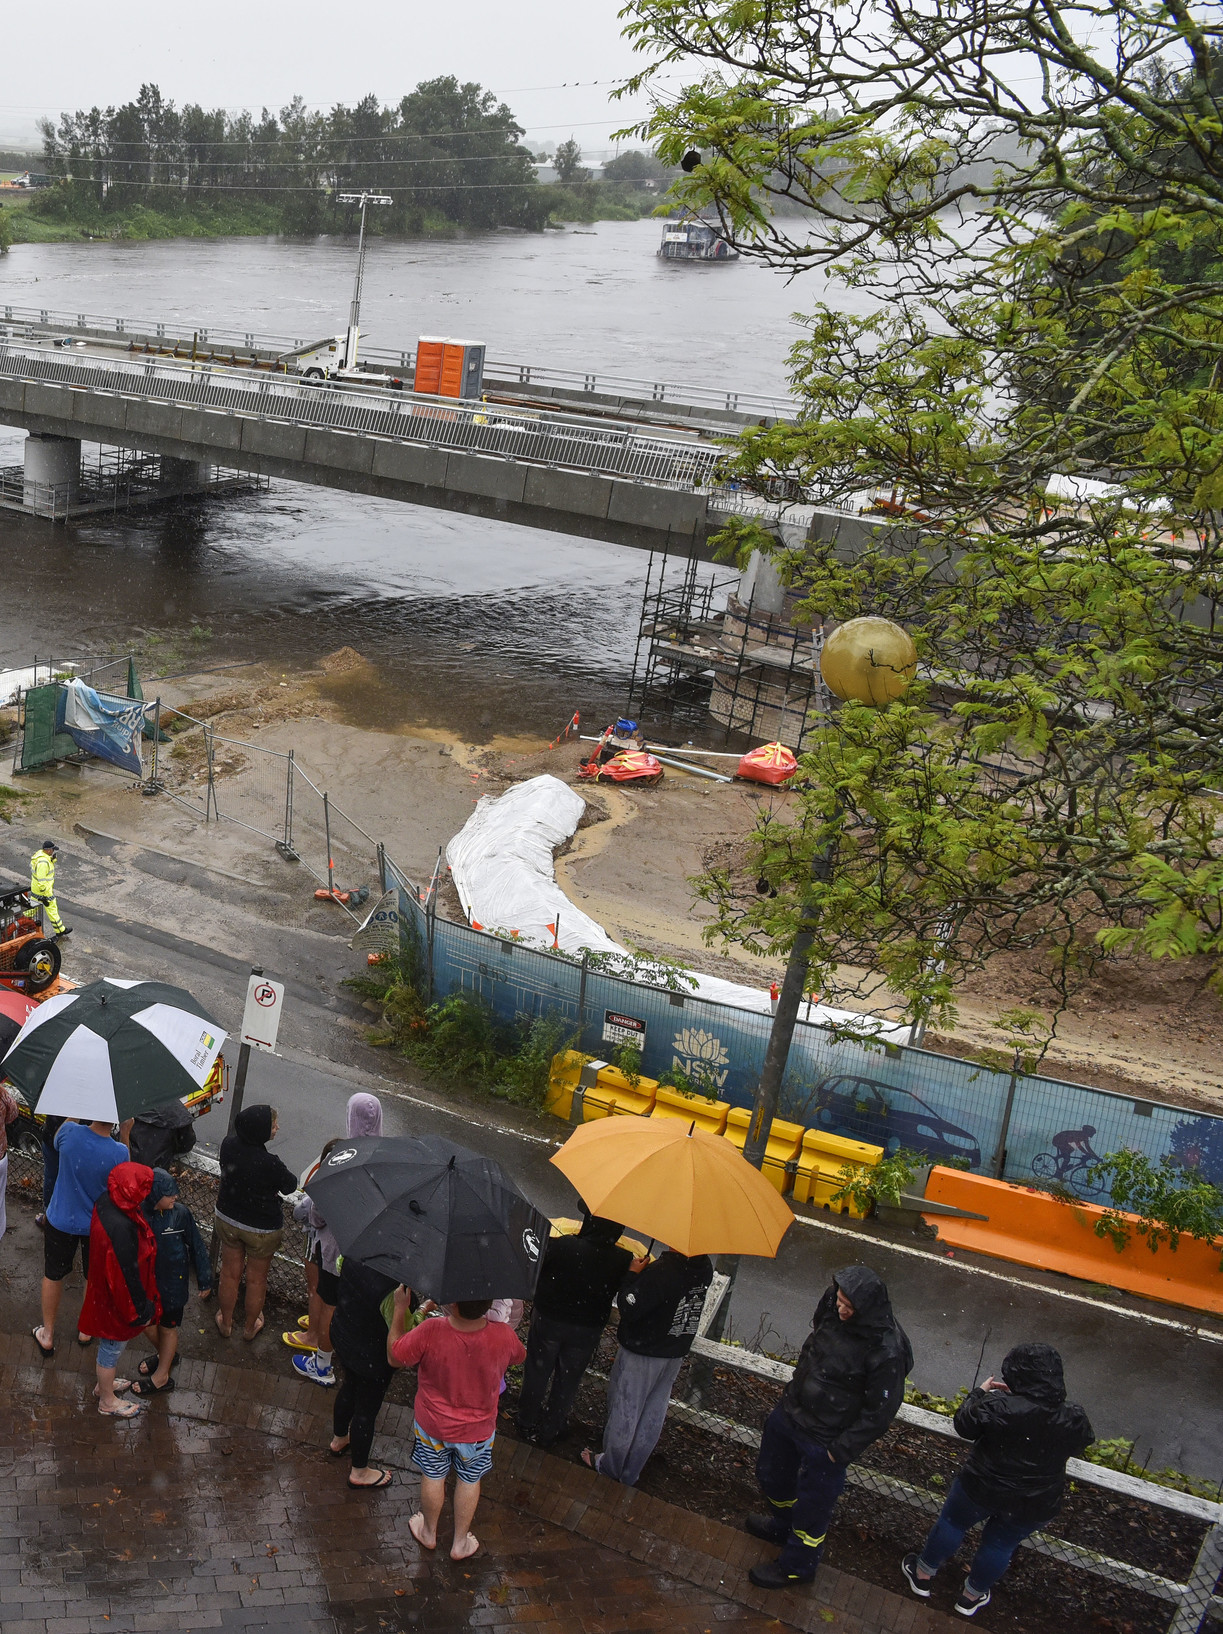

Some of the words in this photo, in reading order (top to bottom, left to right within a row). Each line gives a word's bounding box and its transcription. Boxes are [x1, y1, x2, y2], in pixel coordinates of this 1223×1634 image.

[613, 1016, 637, 1027] DANGER
[610, 1025, 625, 1033] KEEP
[626, 1030, 638, 1038] OUT
[672, 1055, 729, 1087] NSW
